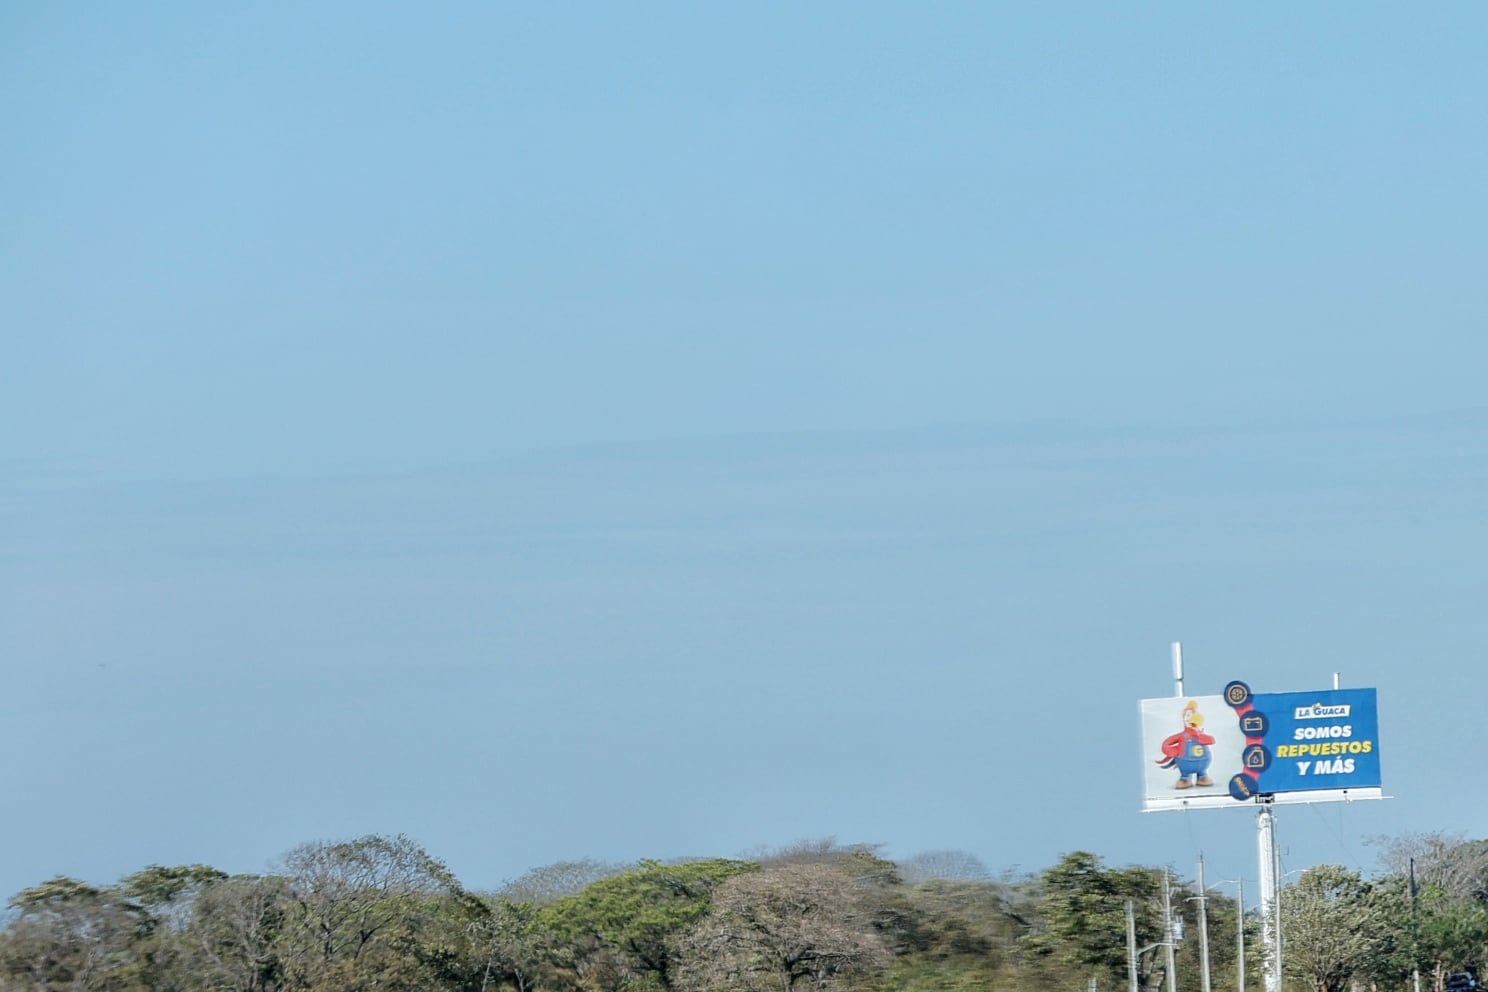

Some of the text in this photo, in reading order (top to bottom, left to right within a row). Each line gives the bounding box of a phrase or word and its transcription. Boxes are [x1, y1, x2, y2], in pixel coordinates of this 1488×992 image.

[1298, 707, 1346, 717] LA GUACA
[1294, 725, 1353, 740] SOMOS
[1276, 740, 1373, 758] REPUESTOS
[1296, 755, 1356, 776] Y MÁS
